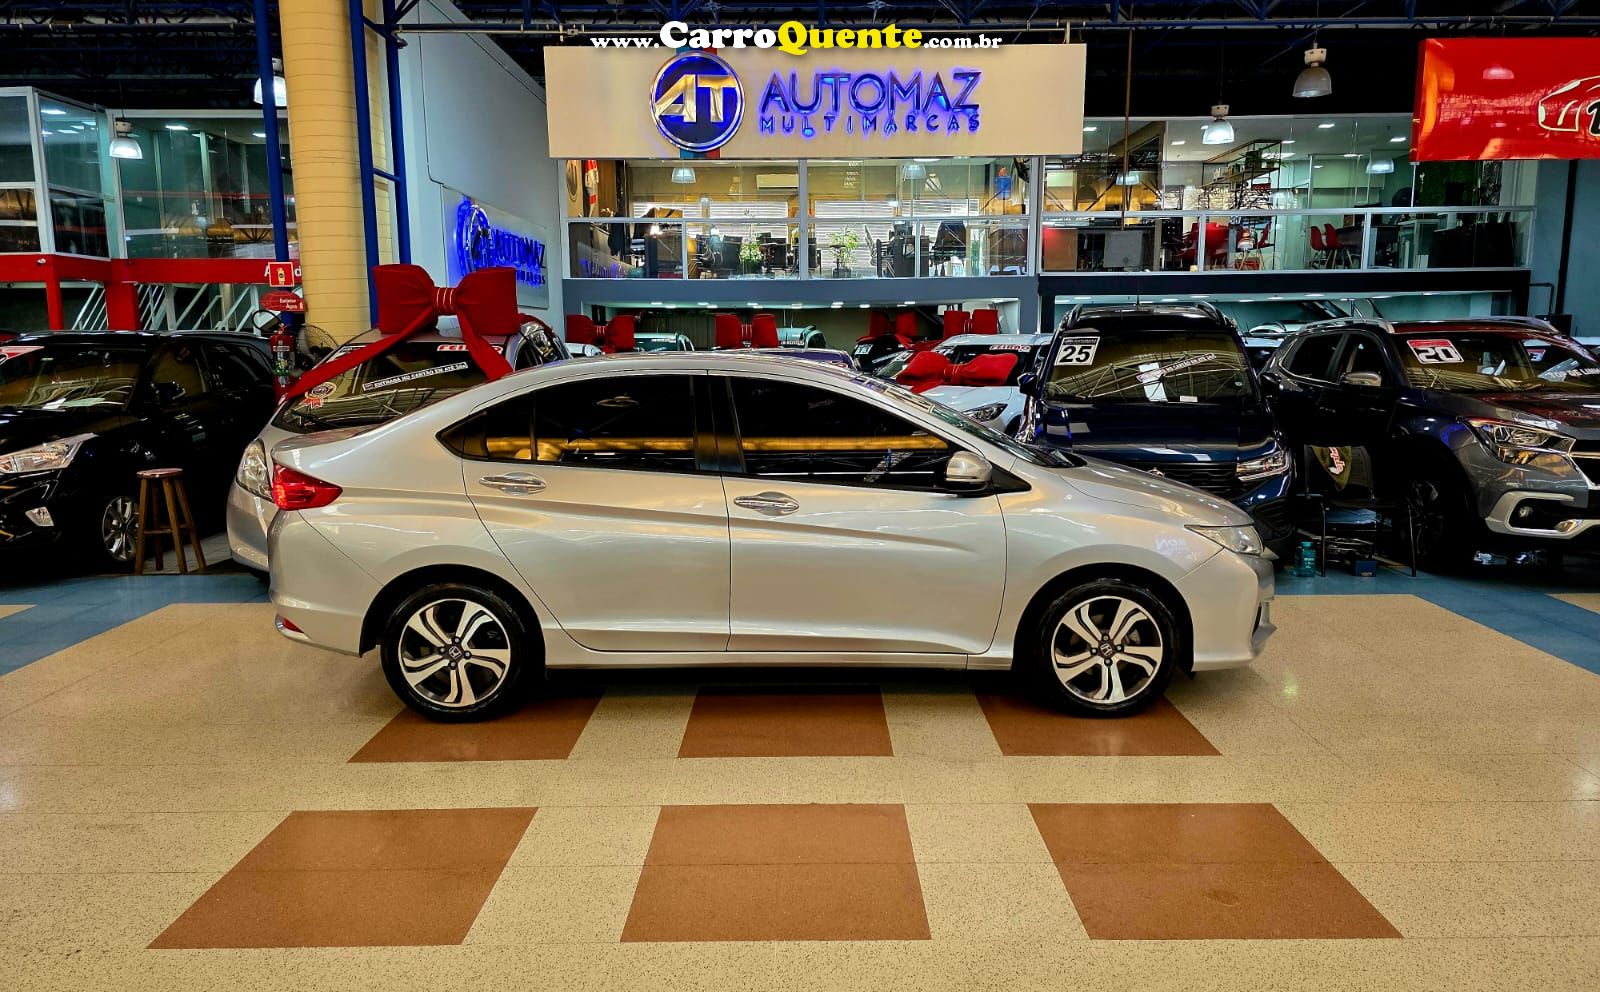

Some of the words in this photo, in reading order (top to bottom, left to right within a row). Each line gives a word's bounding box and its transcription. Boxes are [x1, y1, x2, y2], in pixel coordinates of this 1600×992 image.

[653, 74, 738, 123] AT
[760, 70, 983, 113] AUTOMAZ
[760, 114, 981, 135] MULTIMARCAS
[1058, 345, 1092, 363] 25
[1415, 345, 1461, 362] 20
